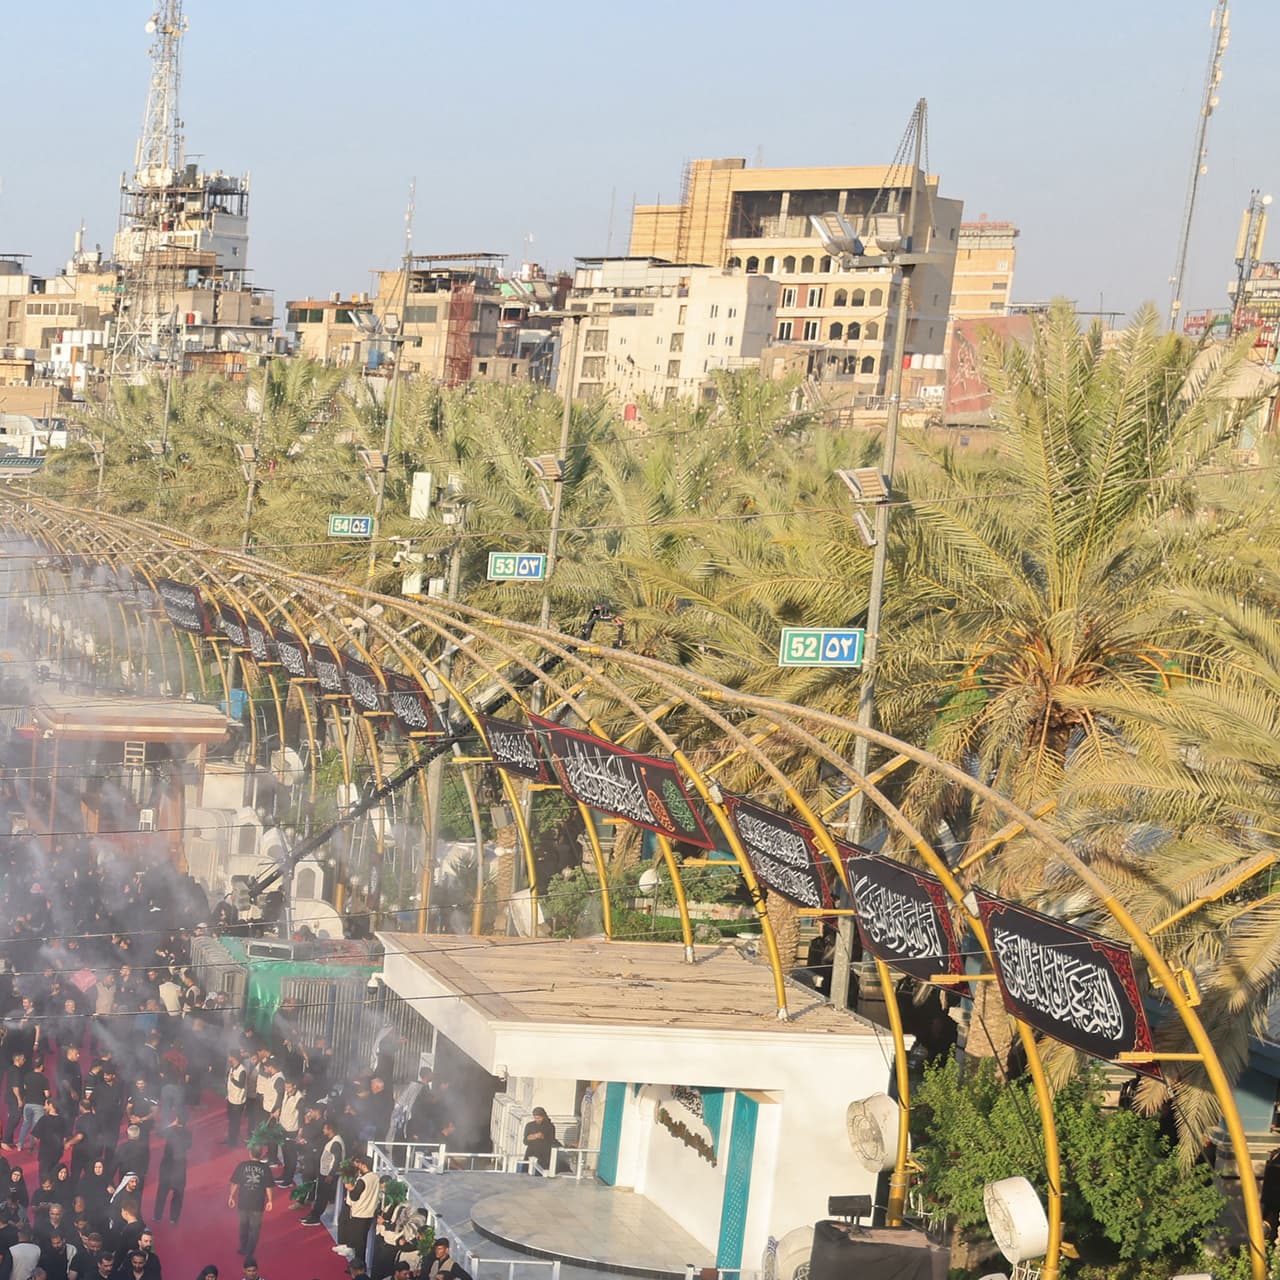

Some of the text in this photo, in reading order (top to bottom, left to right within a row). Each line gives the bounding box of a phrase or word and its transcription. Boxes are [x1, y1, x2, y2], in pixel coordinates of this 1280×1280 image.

[334, 519, 349, 532] 54
[352, 519, 367, 532] ٥٤
[495, 558, 515, 575] 53
[518, 559, 539, 576] ٥٣
[790, 636, 818, 658] 52
[825, 637, 853, 659] ٥٢
